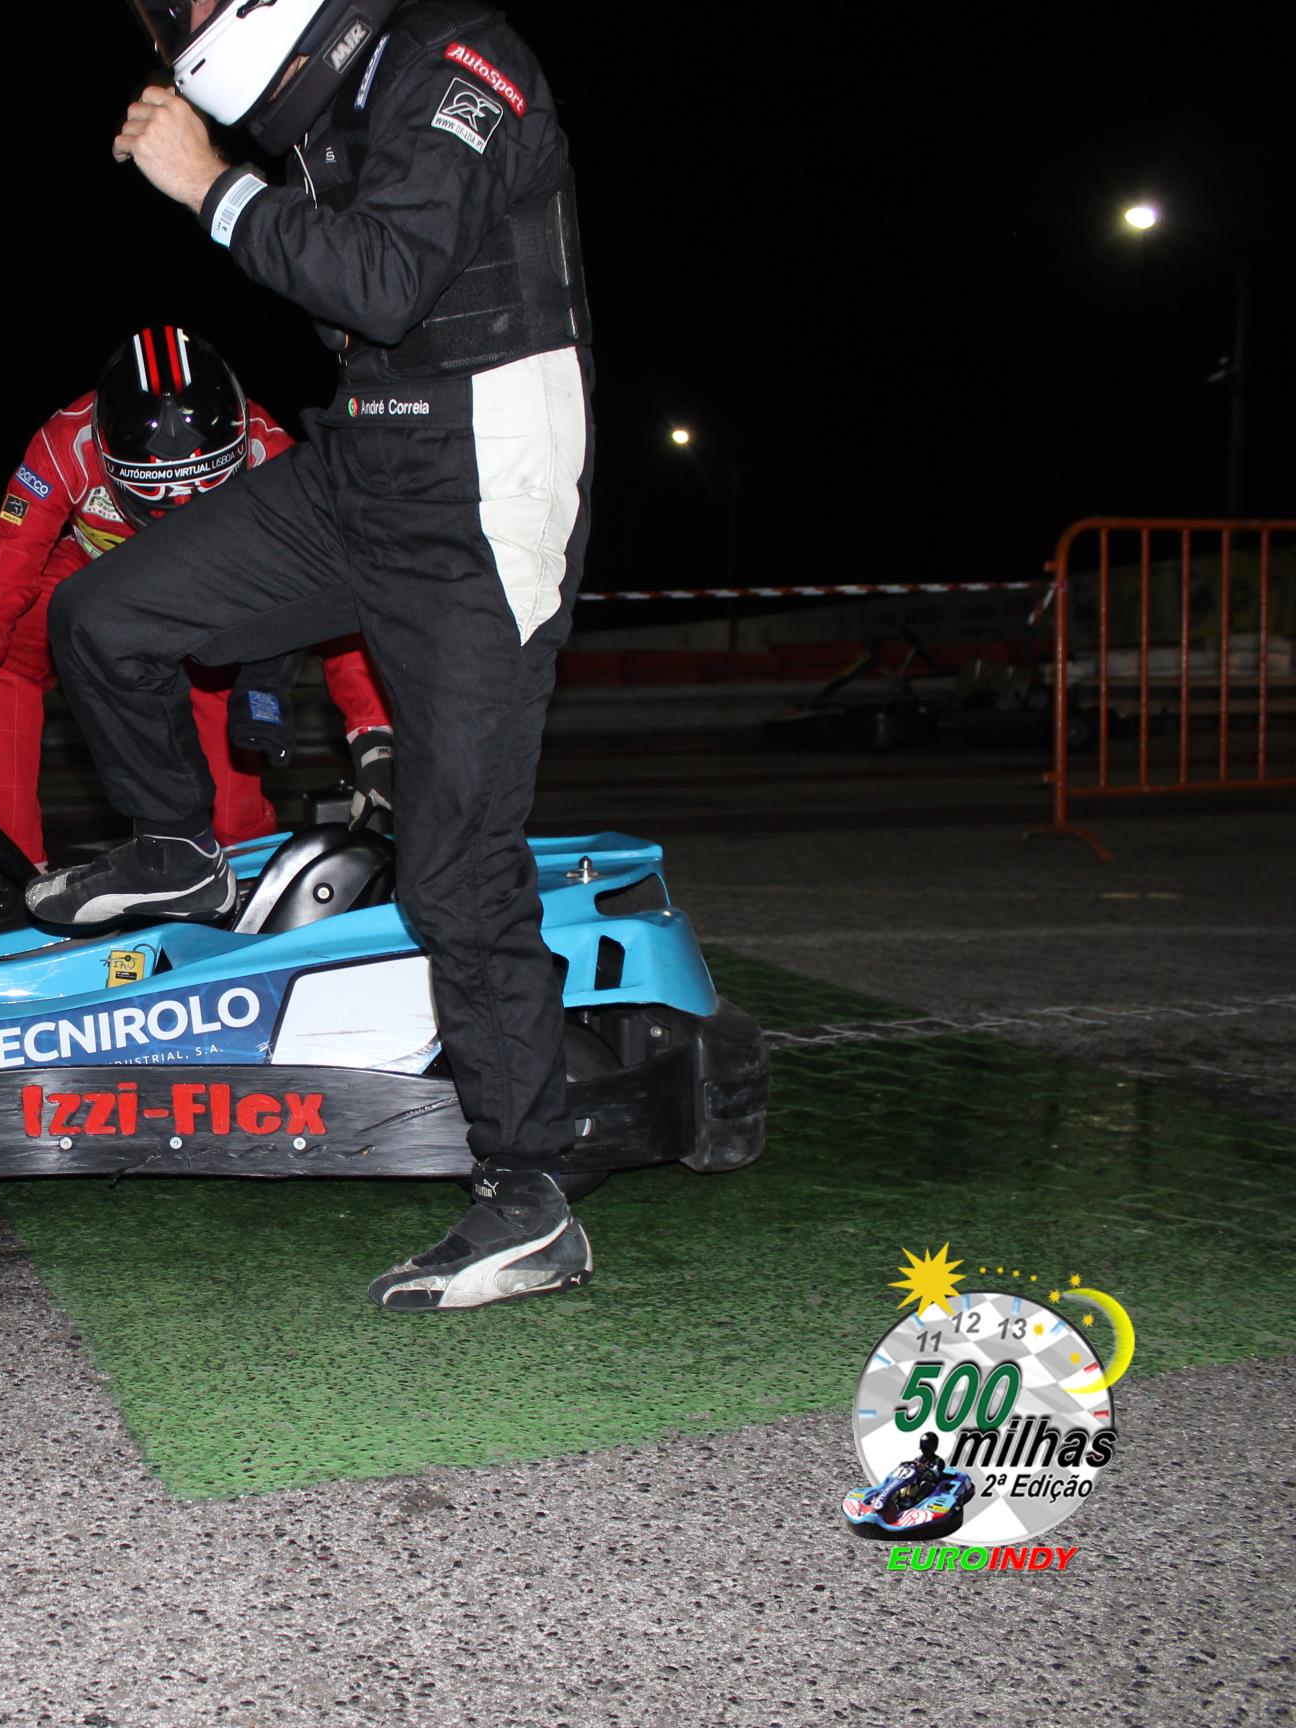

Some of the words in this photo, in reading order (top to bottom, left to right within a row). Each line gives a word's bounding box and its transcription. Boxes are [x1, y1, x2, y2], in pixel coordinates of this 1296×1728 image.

[447, 45, 525, 112] AutoSport
[361, 400, 385, 415] André
[388, 399, 430, 415] Correia
[18, 465, 49, 496] parco
[119, 468, 173, 480] AUTÓDROMO
[174, 462, 211, 478] VIRTUAL
[211, 452, 236, 470] LISBOA
[21, 1082, 328, 1137] Izzi-Flex
